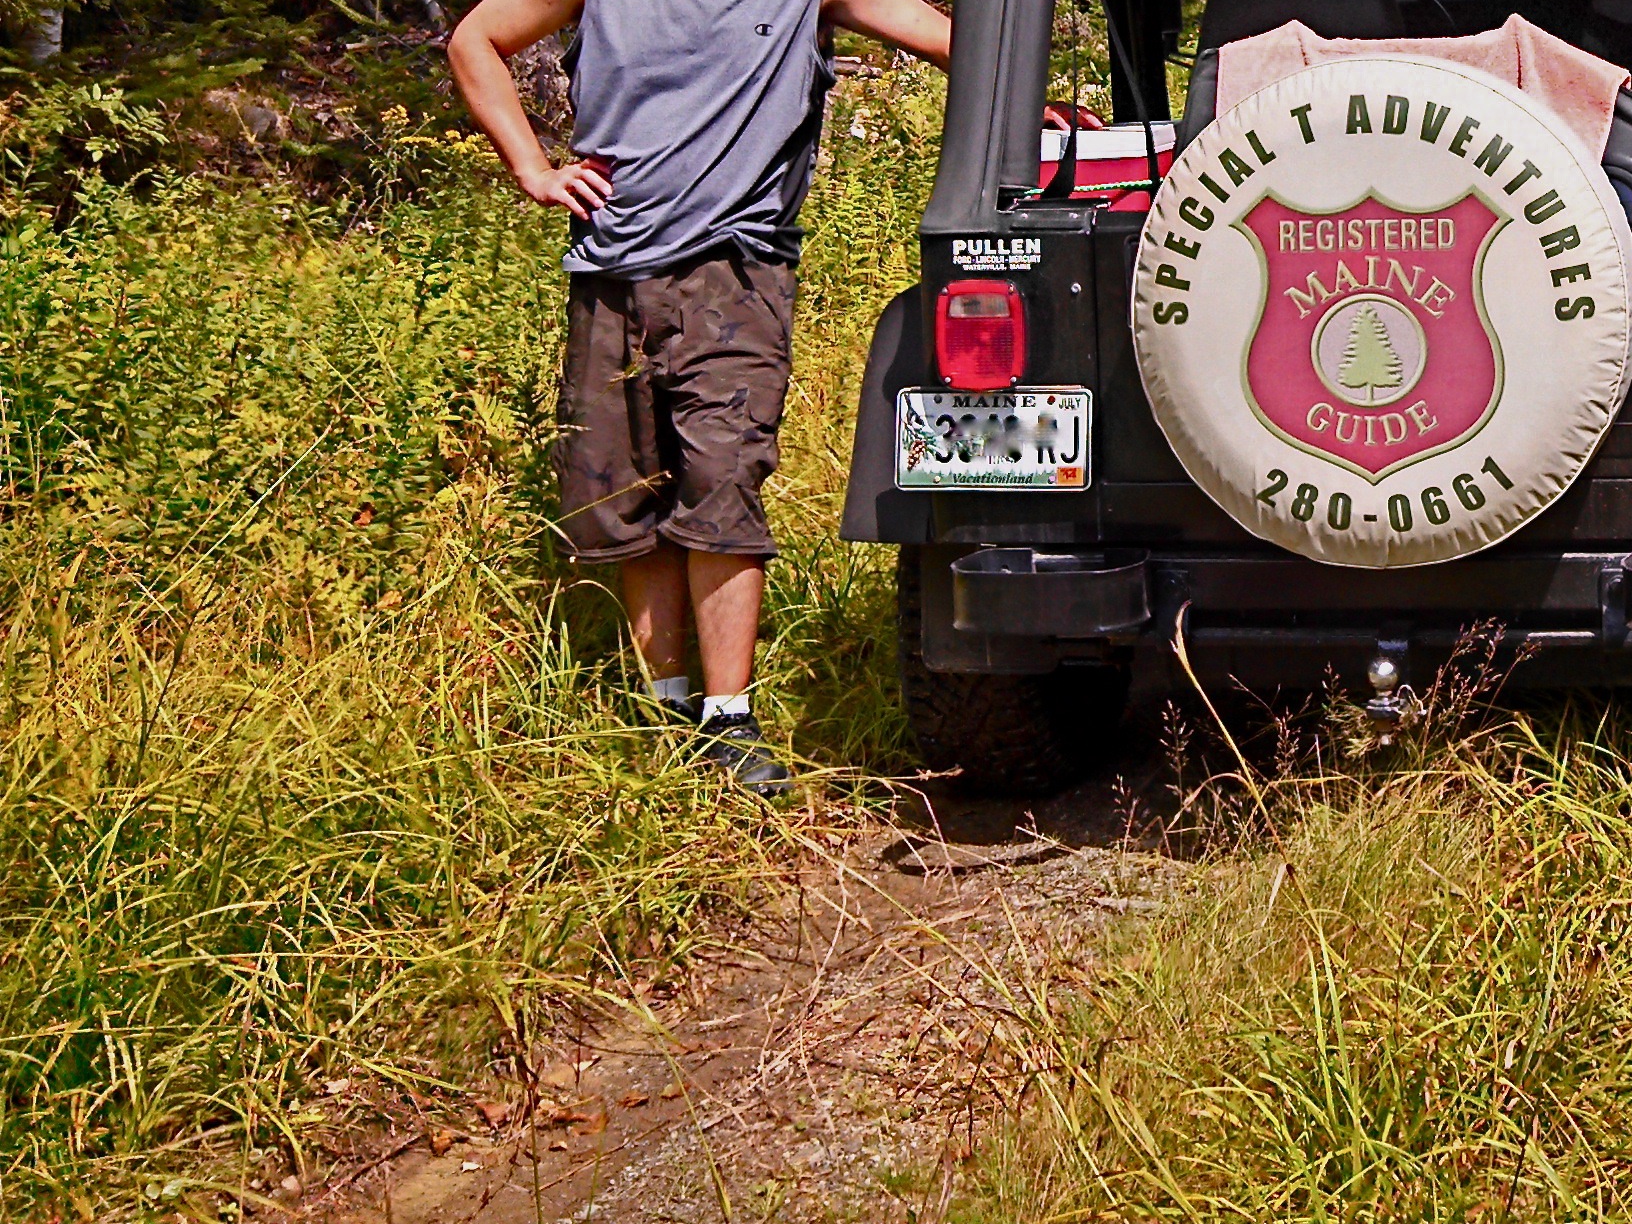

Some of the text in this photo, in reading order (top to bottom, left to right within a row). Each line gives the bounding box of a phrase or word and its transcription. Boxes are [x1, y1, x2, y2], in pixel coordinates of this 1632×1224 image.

[1153, 94, 1596, 326] SPECIAL T ADVENTURES
[952, 238, 1041, 256] PULLEN
[1279, 218, 1456, 253] REGISTERED
[1282, 255, 1458, 321] MAINE
[952, 395, 1037, 408] MAINE
[1306, 400, 1440, 446] GUIDE
[952, 472, 1034, 485] Vacationland
[1256, 456, 1516, 532] 280-0661
